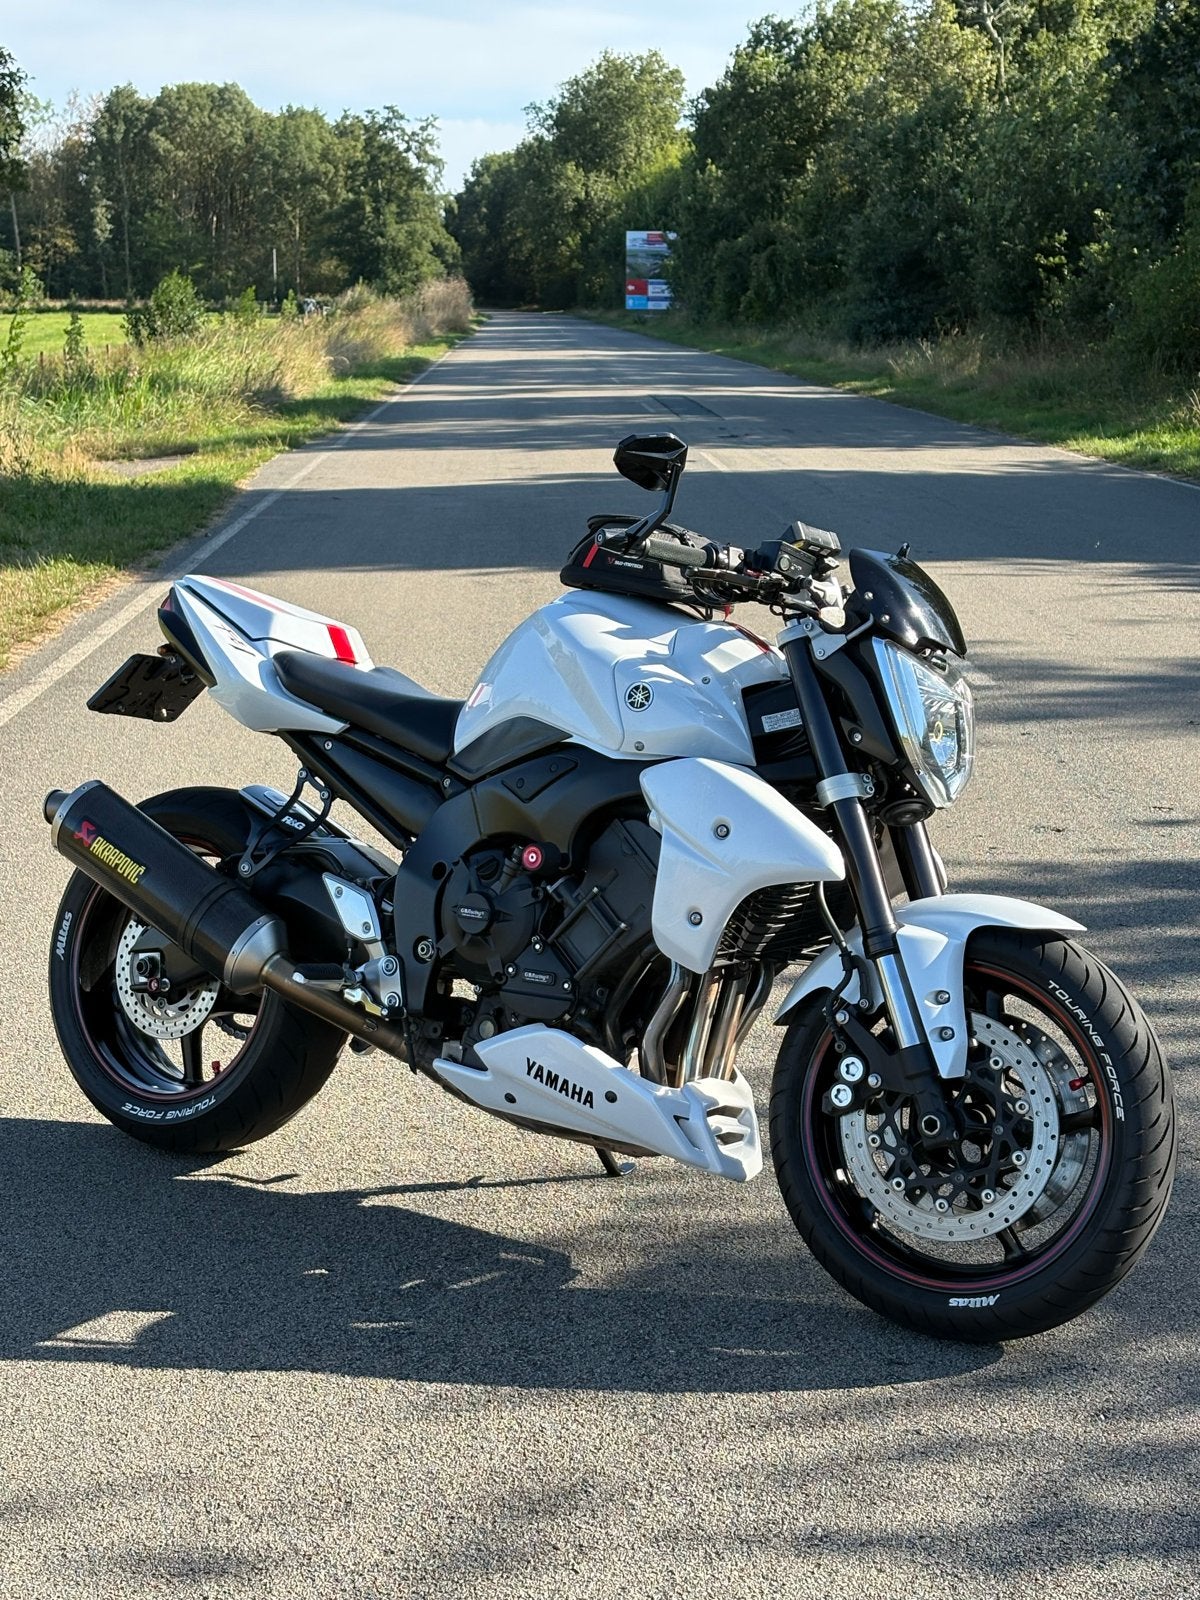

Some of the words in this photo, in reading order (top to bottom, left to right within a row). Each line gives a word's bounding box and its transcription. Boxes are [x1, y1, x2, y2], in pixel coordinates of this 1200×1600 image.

[281, 815, 306, 830] R&G
[56, 911, 72, 961] Mitas
[1048, 980, 1104, 1047] TOURING
[1100, 1053, 1125, 1121] FORCE
[526, 1057, 594, 1110] YAMAHA
[121, 1102, 164, 1119] FORCE
[165, 1095, 216, 1119] TOURING
[949, 1293, 1000, 1308] Mitas
